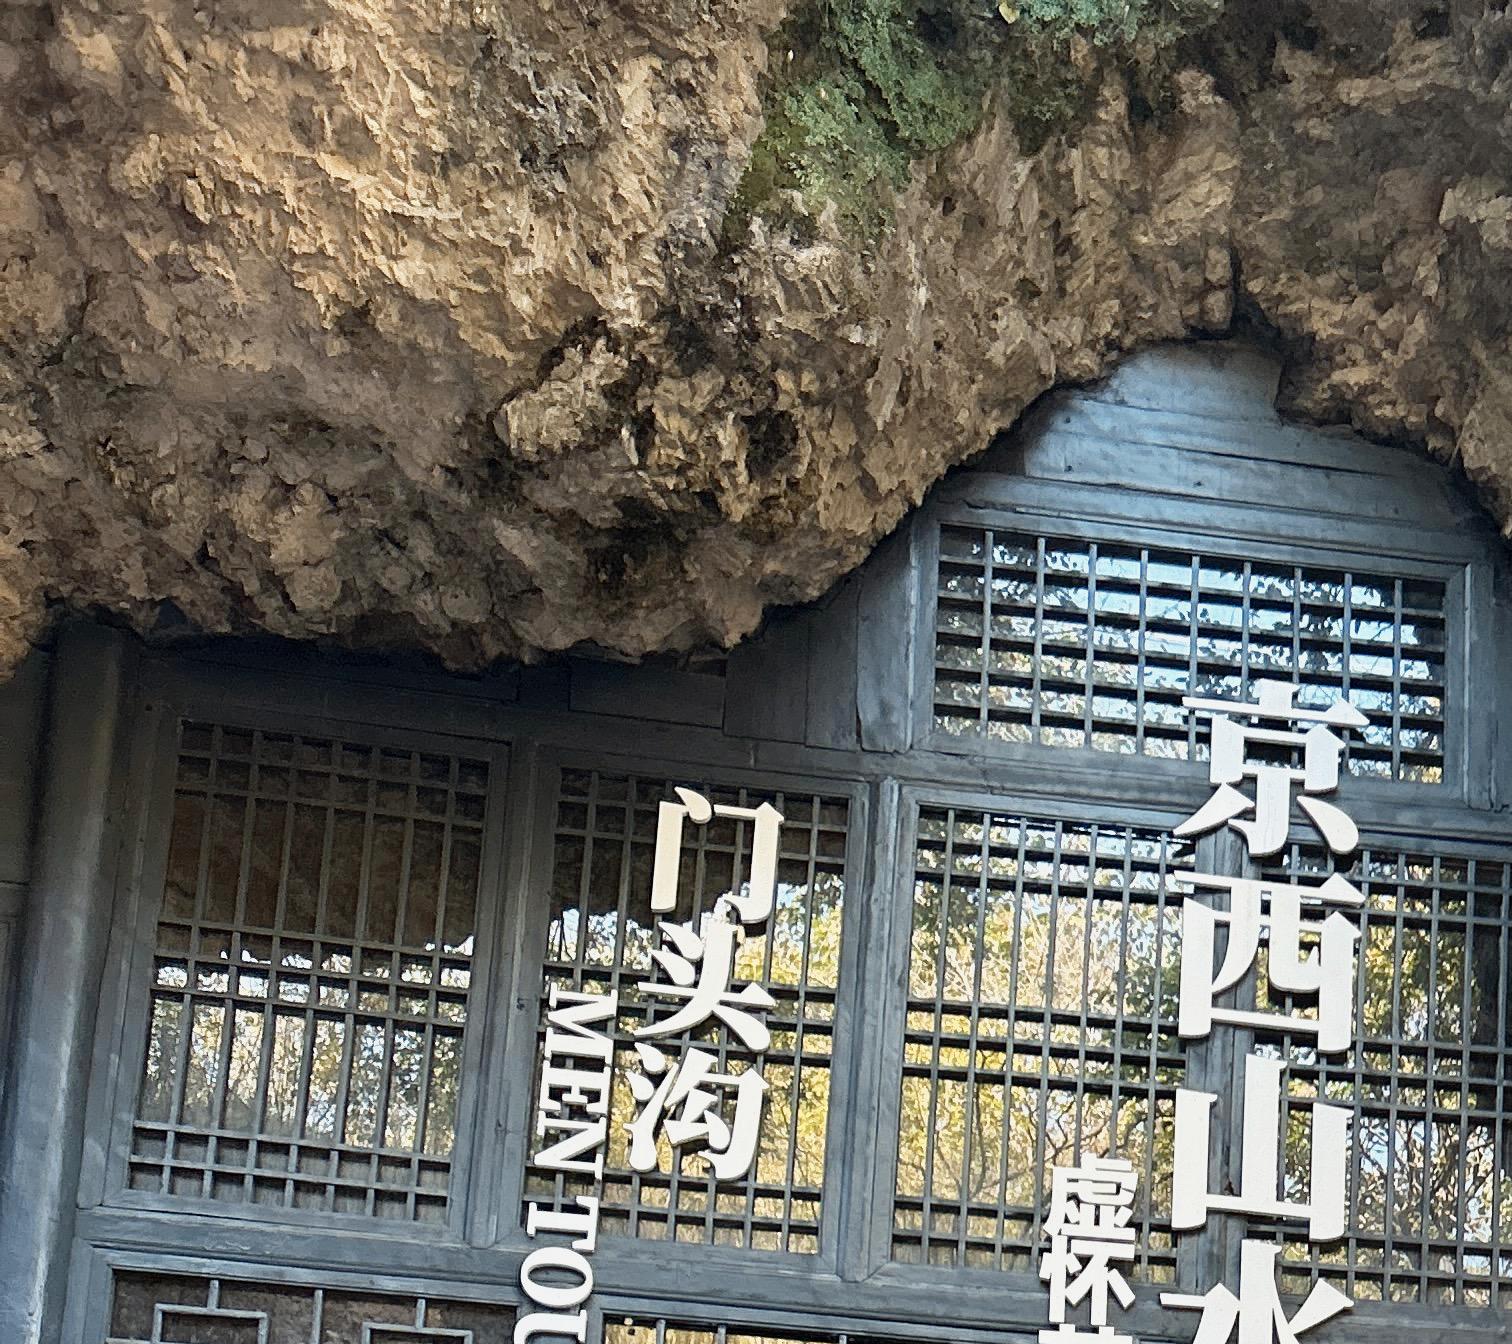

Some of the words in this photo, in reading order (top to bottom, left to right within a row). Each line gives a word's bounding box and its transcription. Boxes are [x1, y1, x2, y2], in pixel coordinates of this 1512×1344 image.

[531, 983, 618, 1180] MEN
[627, 787, 785, 1182] 门头沟
